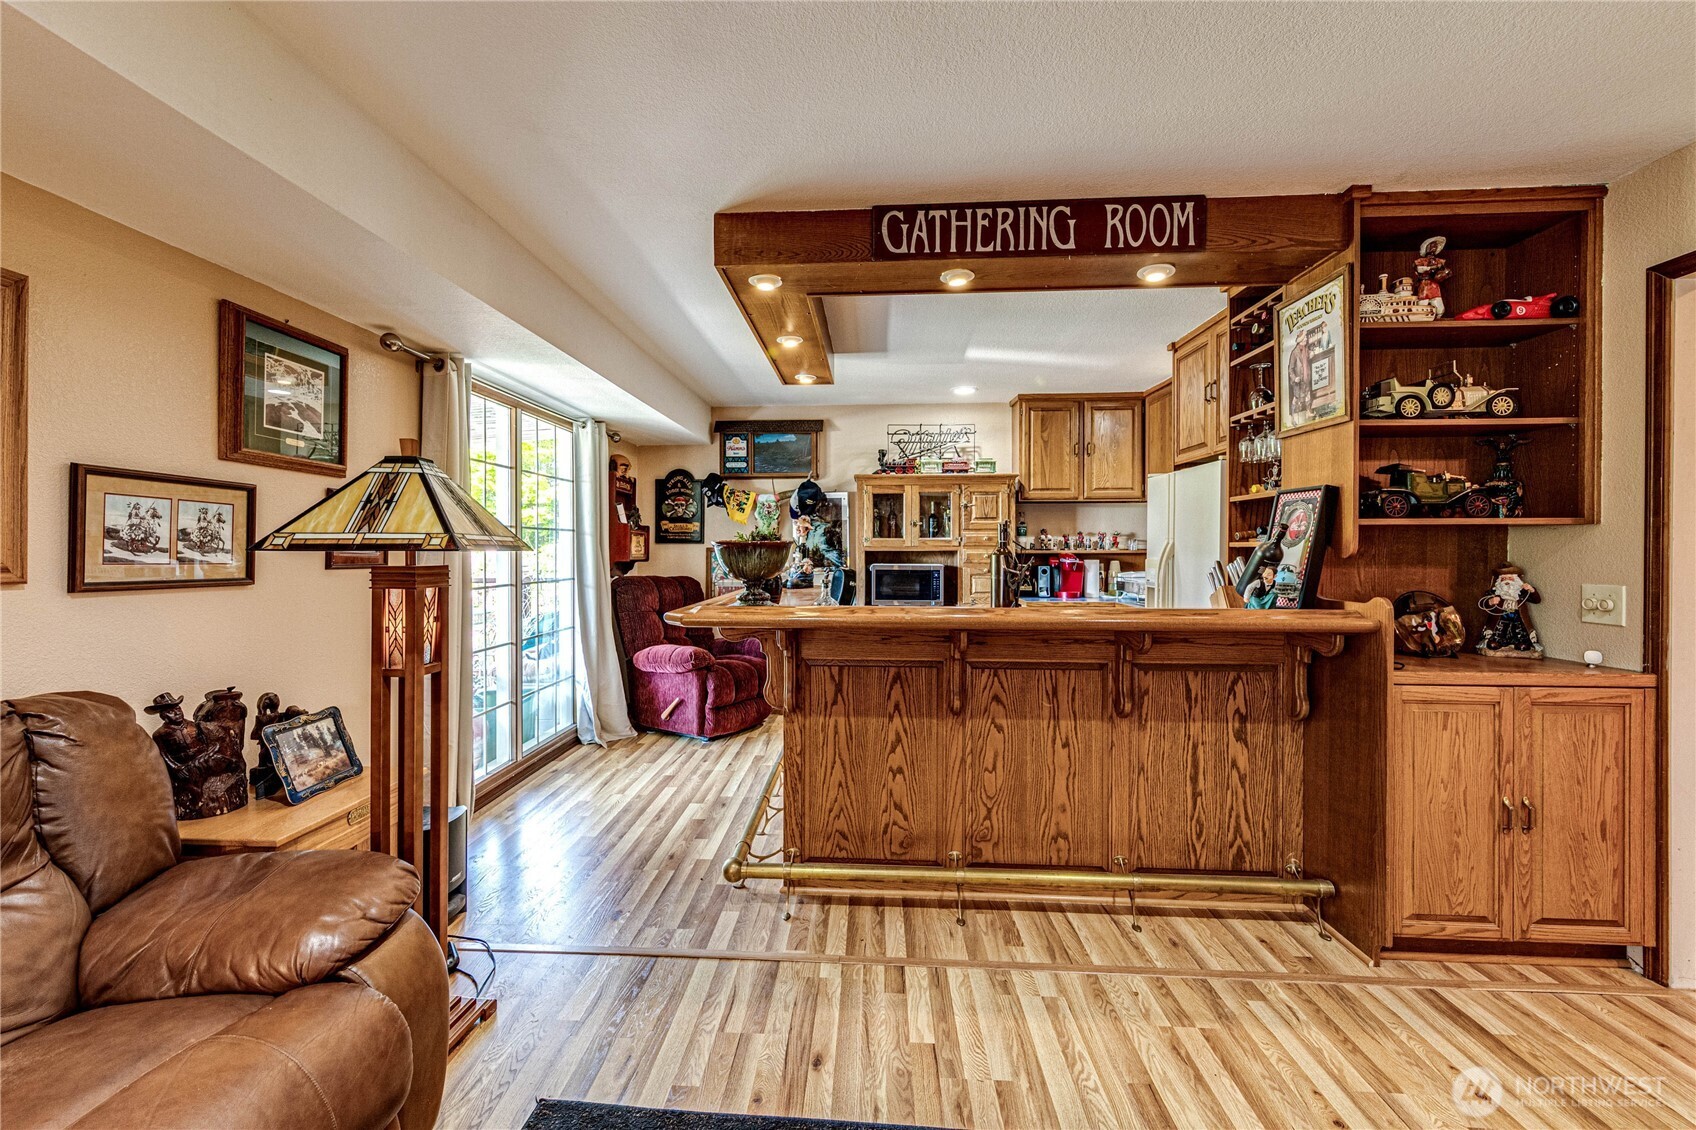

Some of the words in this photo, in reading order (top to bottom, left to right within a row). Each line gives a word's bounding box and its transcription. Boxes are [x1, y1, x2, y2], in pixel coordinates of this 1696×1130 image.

[881, 206, 1076, 254] GATHERING
[1104, 202, 1196, 249] ROOM
[1284, 291, 1337, 334] TEACHER'S
